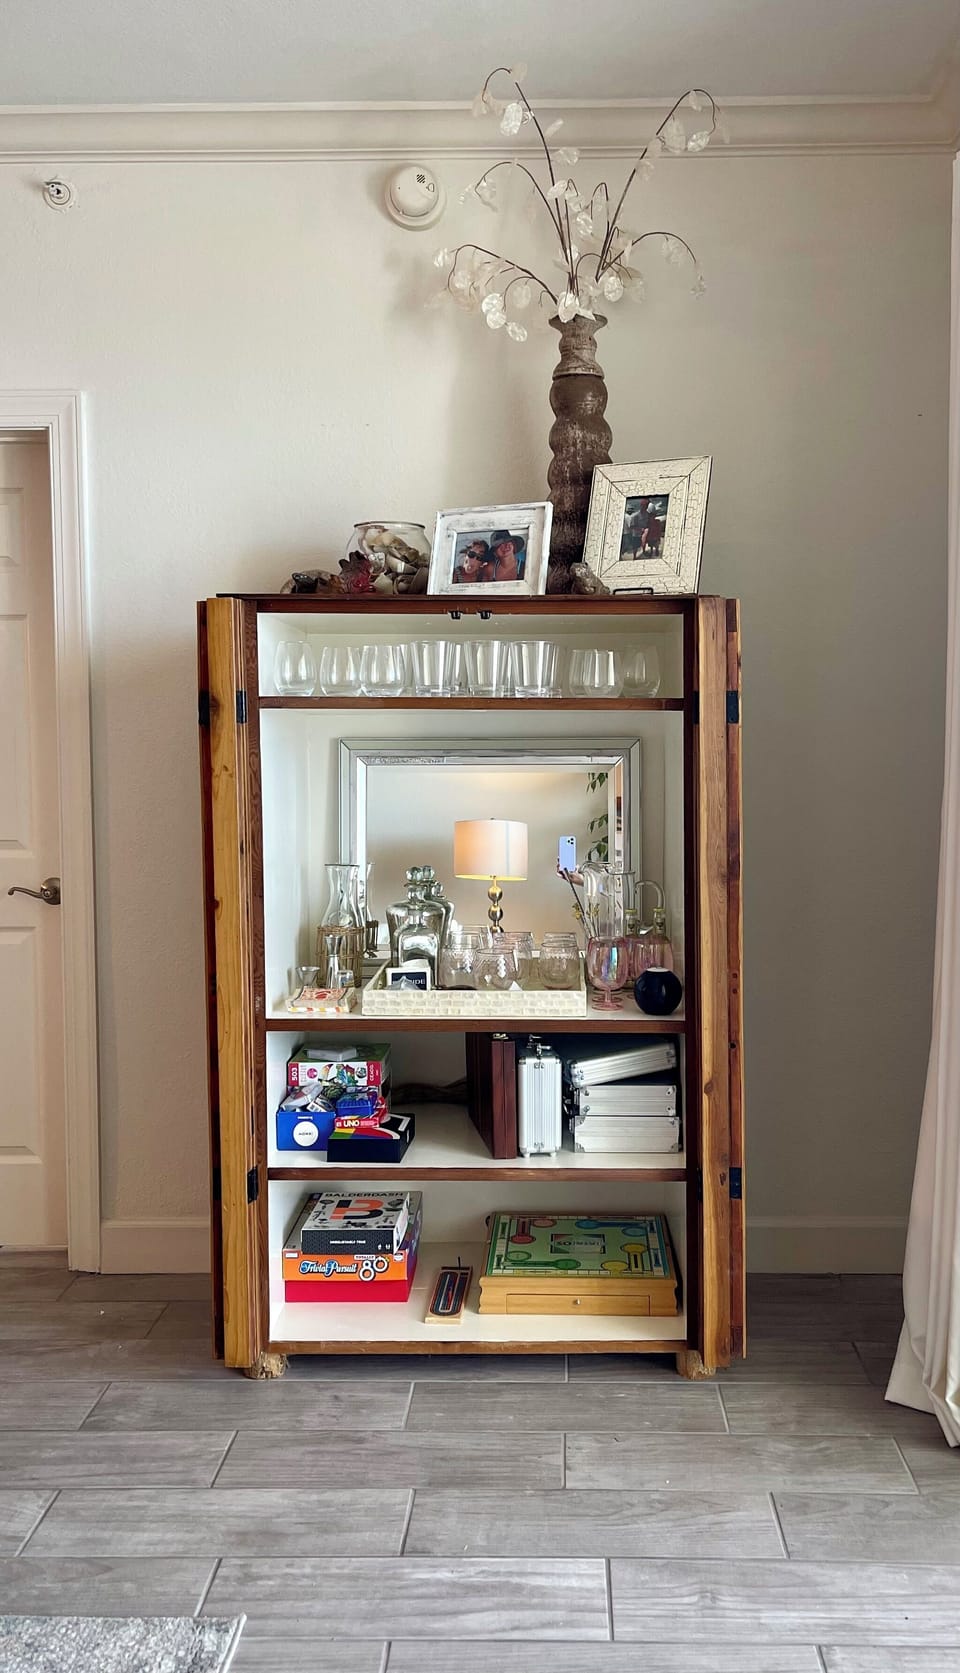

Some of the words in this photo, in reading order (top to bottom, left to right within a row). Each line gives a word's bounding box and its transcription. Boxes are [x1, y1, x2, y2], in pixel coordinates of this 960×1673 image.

[343, 1119, 360, 1128] UNO
[300, 1260, 328, 1274] Trivial
[325, 1260, 357, 1277] Pursuit
